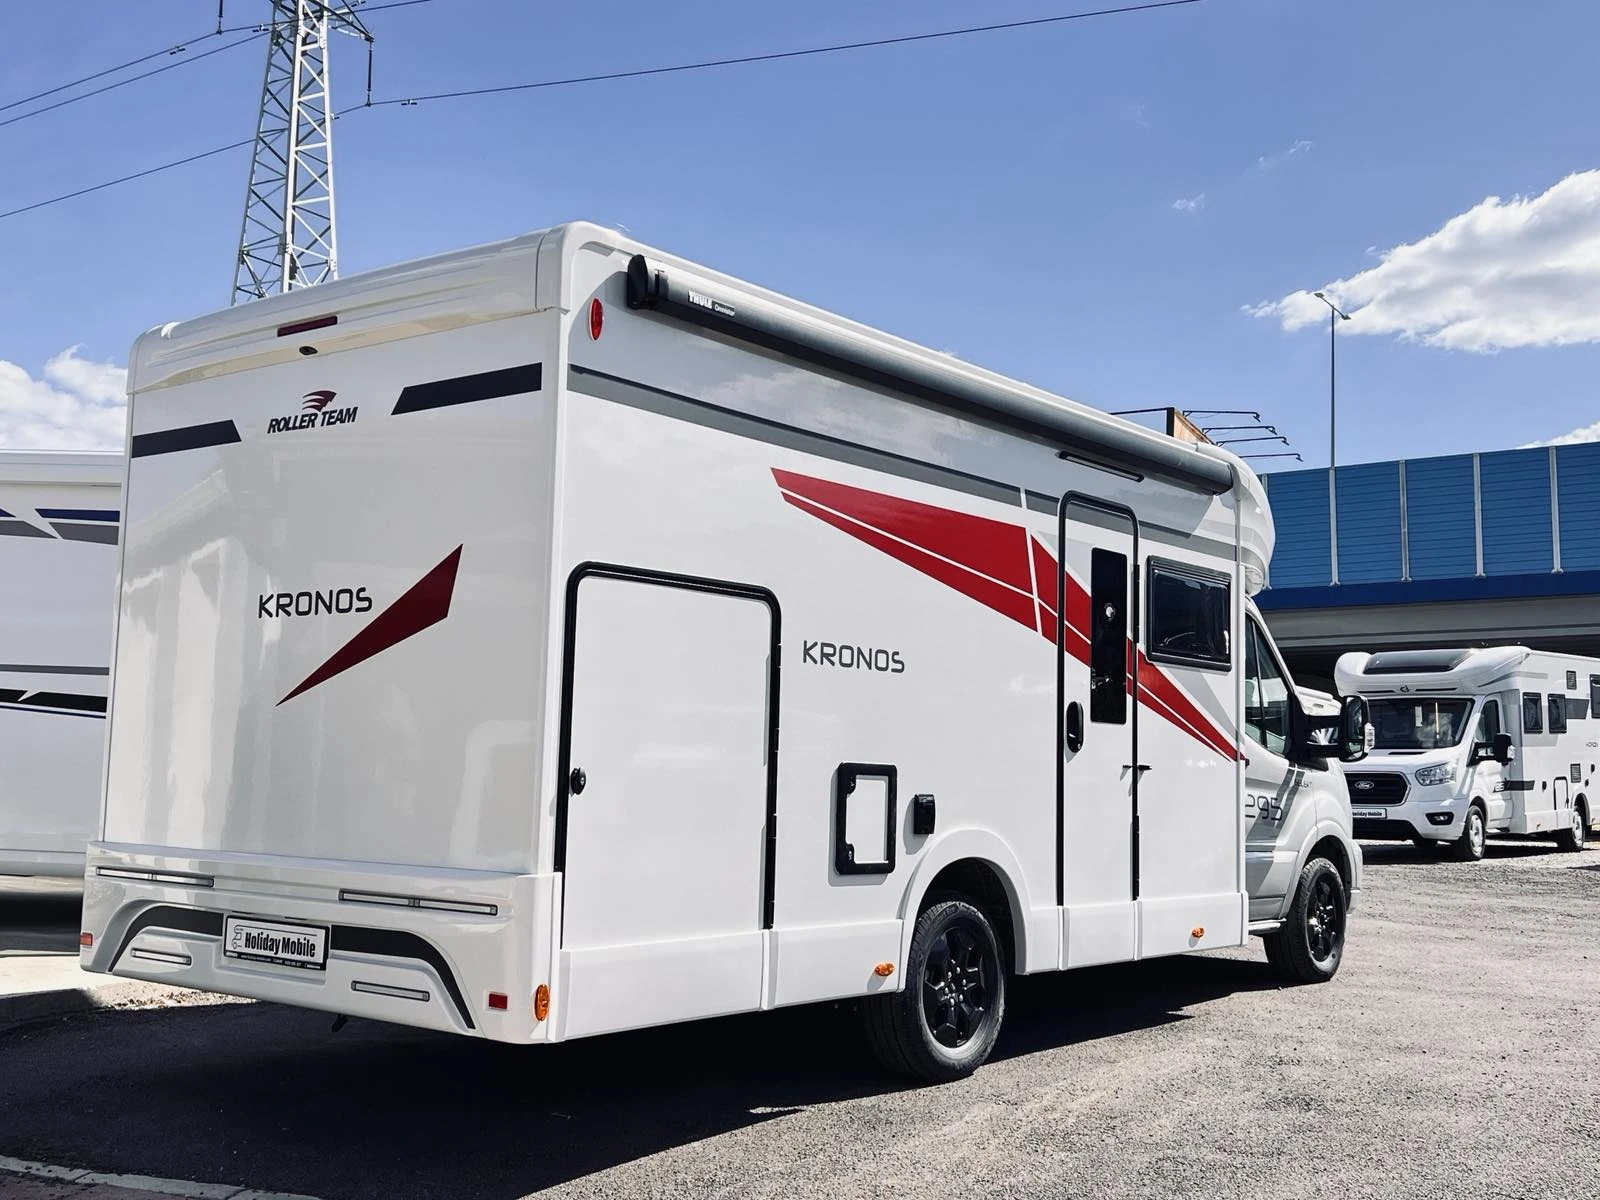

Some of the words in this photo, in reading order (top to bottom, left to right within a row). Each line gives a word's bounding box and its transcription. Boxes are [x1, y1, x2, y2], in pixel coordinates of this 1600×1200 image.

[267, 412, 318, 434] ROLLER
[320, 407, 358, 427] TEAM
[258, 587, 373, 619] KRONOS
[803, 640, 905, 673] KRONOS
[244, 931, 281, 955] Holiday
[281, 936, 316, 958] Mobile
